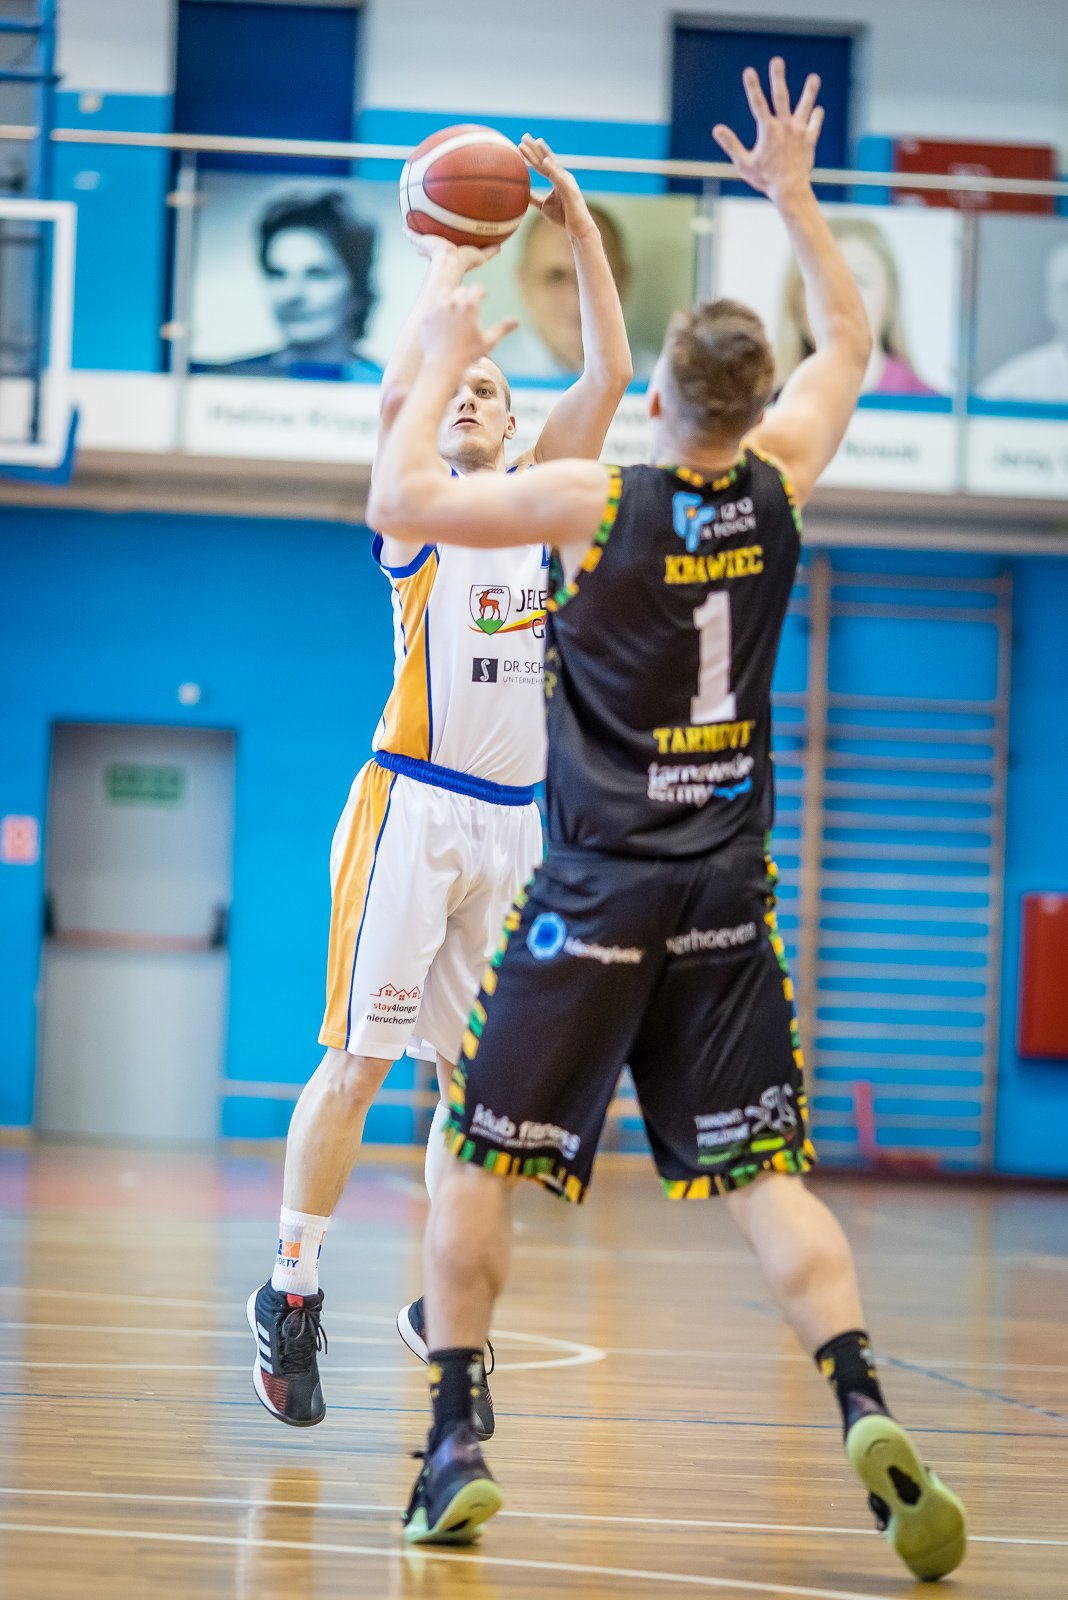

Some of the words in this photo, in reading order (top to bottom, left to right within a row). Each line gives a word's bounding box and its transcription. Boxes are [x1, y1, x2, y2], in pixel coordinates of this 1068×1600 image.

[664, 545, 764, 585] KRAWIEC
[503, 660, 522, 673] DR.
[690, 590, 736, 724] 1
